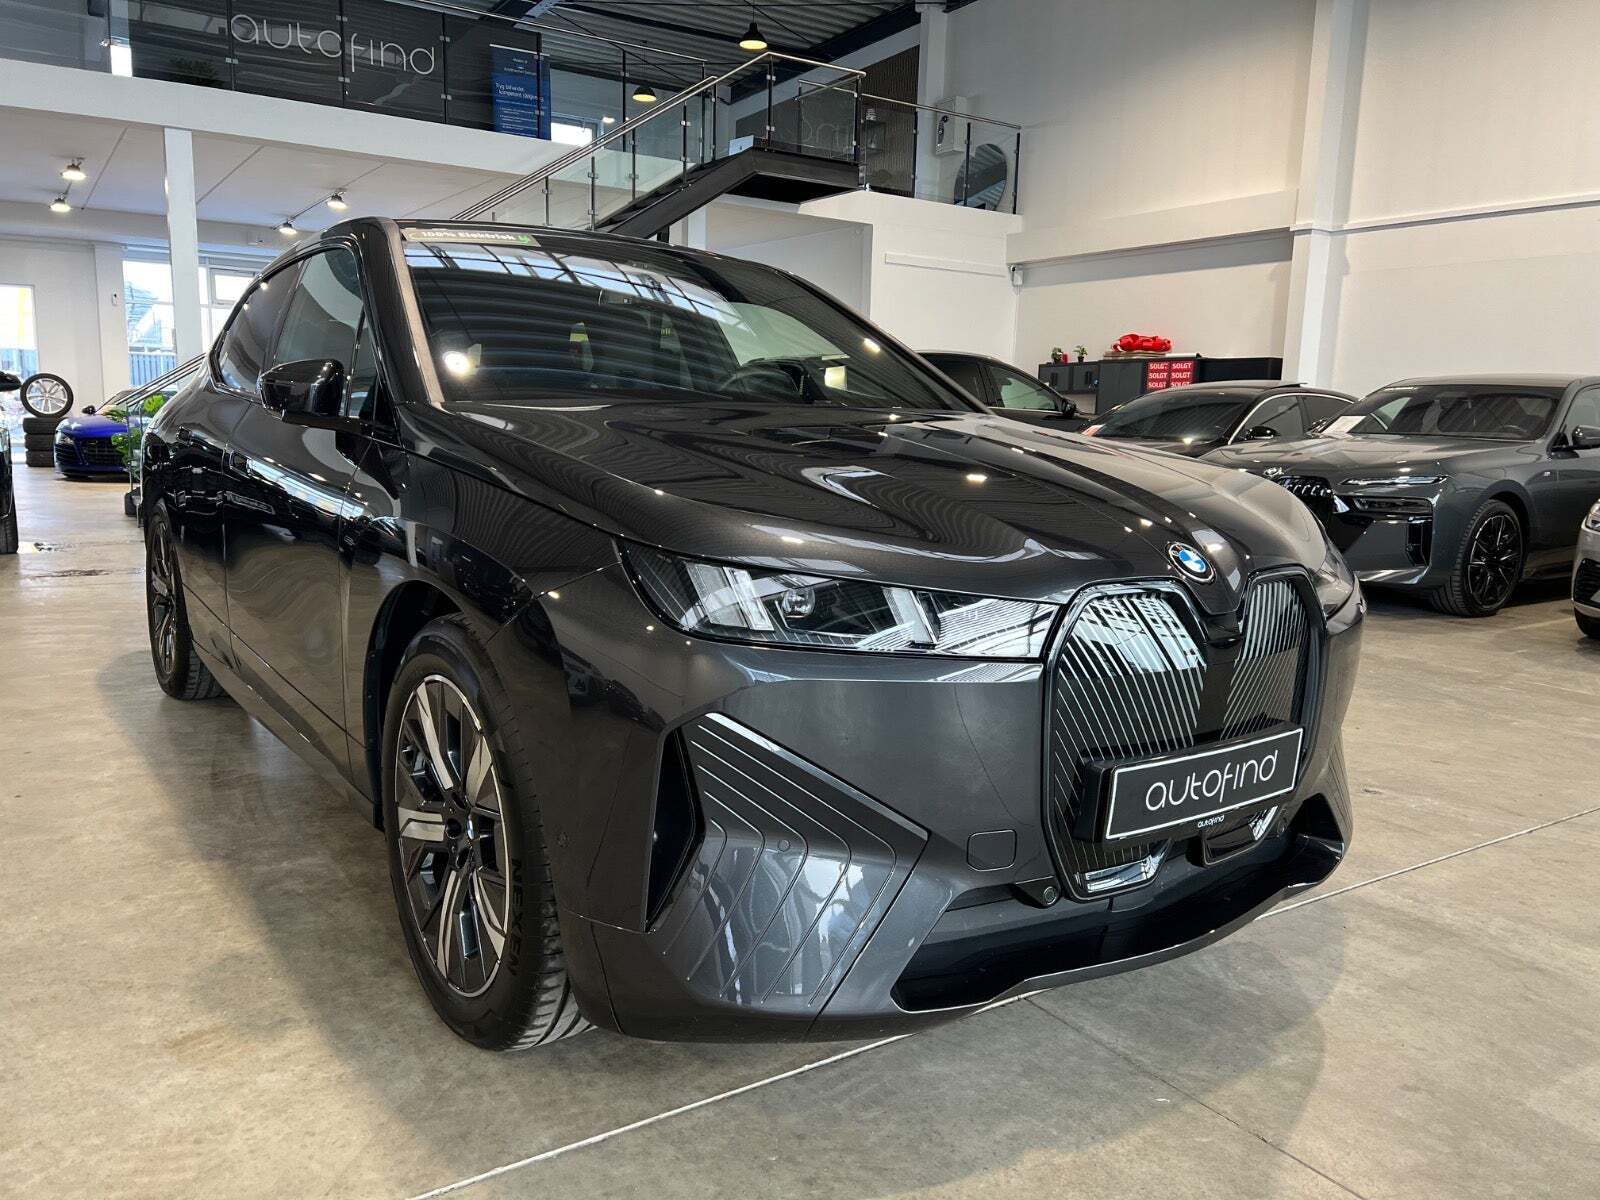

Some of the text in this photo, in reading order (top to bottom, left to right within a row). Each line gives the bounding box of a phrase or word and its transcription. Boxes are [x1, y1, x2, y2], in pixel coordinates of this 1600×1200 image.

[230, 14, 435, 75] autofind
[1149, 362, 1169, 370] SOLGT
[1171, 371, 1190, 379] SOLGT
[1145, 749, 1279, 811] autofind
[1197, 814, 1225, 829] autofind
[506, 857, 525, 977] NEXEN
